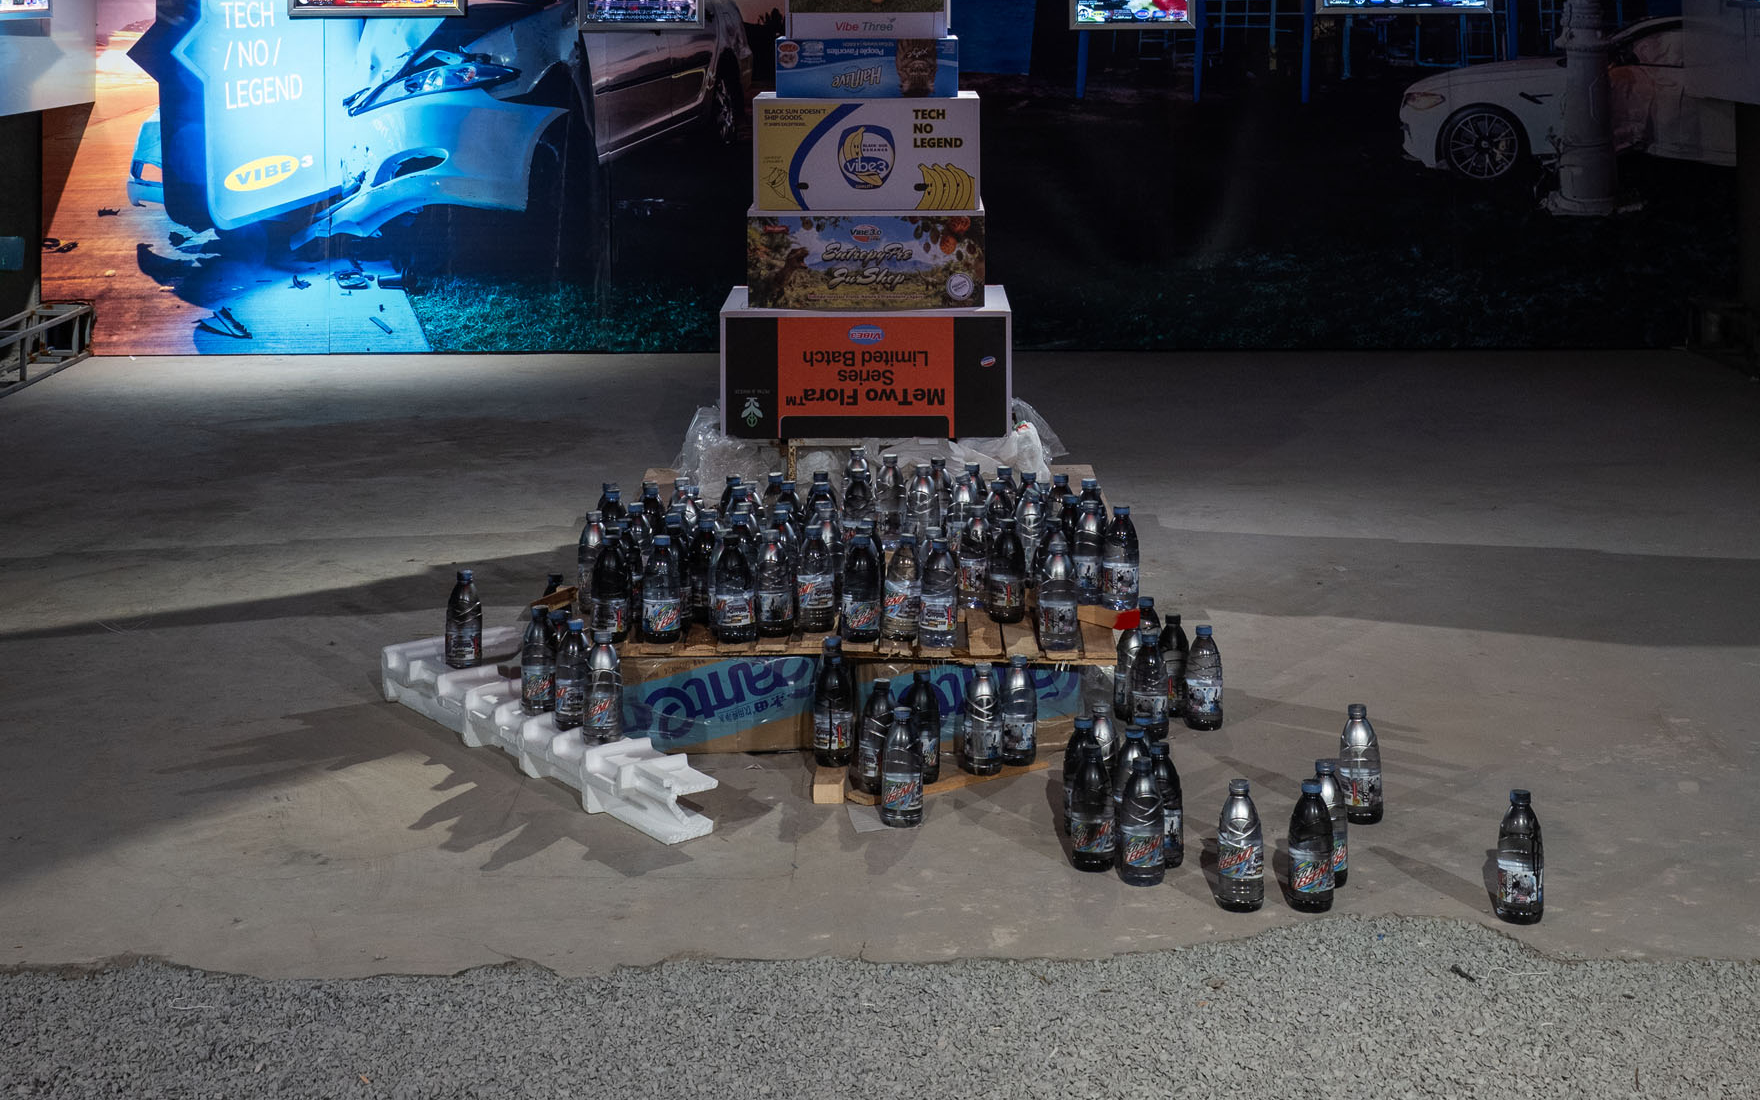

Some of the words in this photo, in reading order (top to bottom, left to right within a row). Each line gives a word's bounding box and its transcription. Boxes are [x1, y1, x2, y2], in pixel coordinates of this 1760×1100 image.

[221, 1, 275, 29] TECH
[835, 22, 860, 33] Vibe
[862, 22, 894, 33] Three
[826, 48, 859, 56] Favorites
[859, 47, 885, 56] People
[225, 73, 303, 110] LEGEND
[913, 108, 946, 120] TECH
[913, 123, 933, 134] NO
[913, 137, 964, 149] LEGEND
[235, 159, 292, 186] VIBE
[300, 154, 314, 168] 3
[846, 155, 887, 173] vibe3
[802, 350, 853, 367] Batch
[861, 350, 929, 367] Limited
[837, 369, 895, 385] Series
[865, 388, 946, 406] MeTwo
